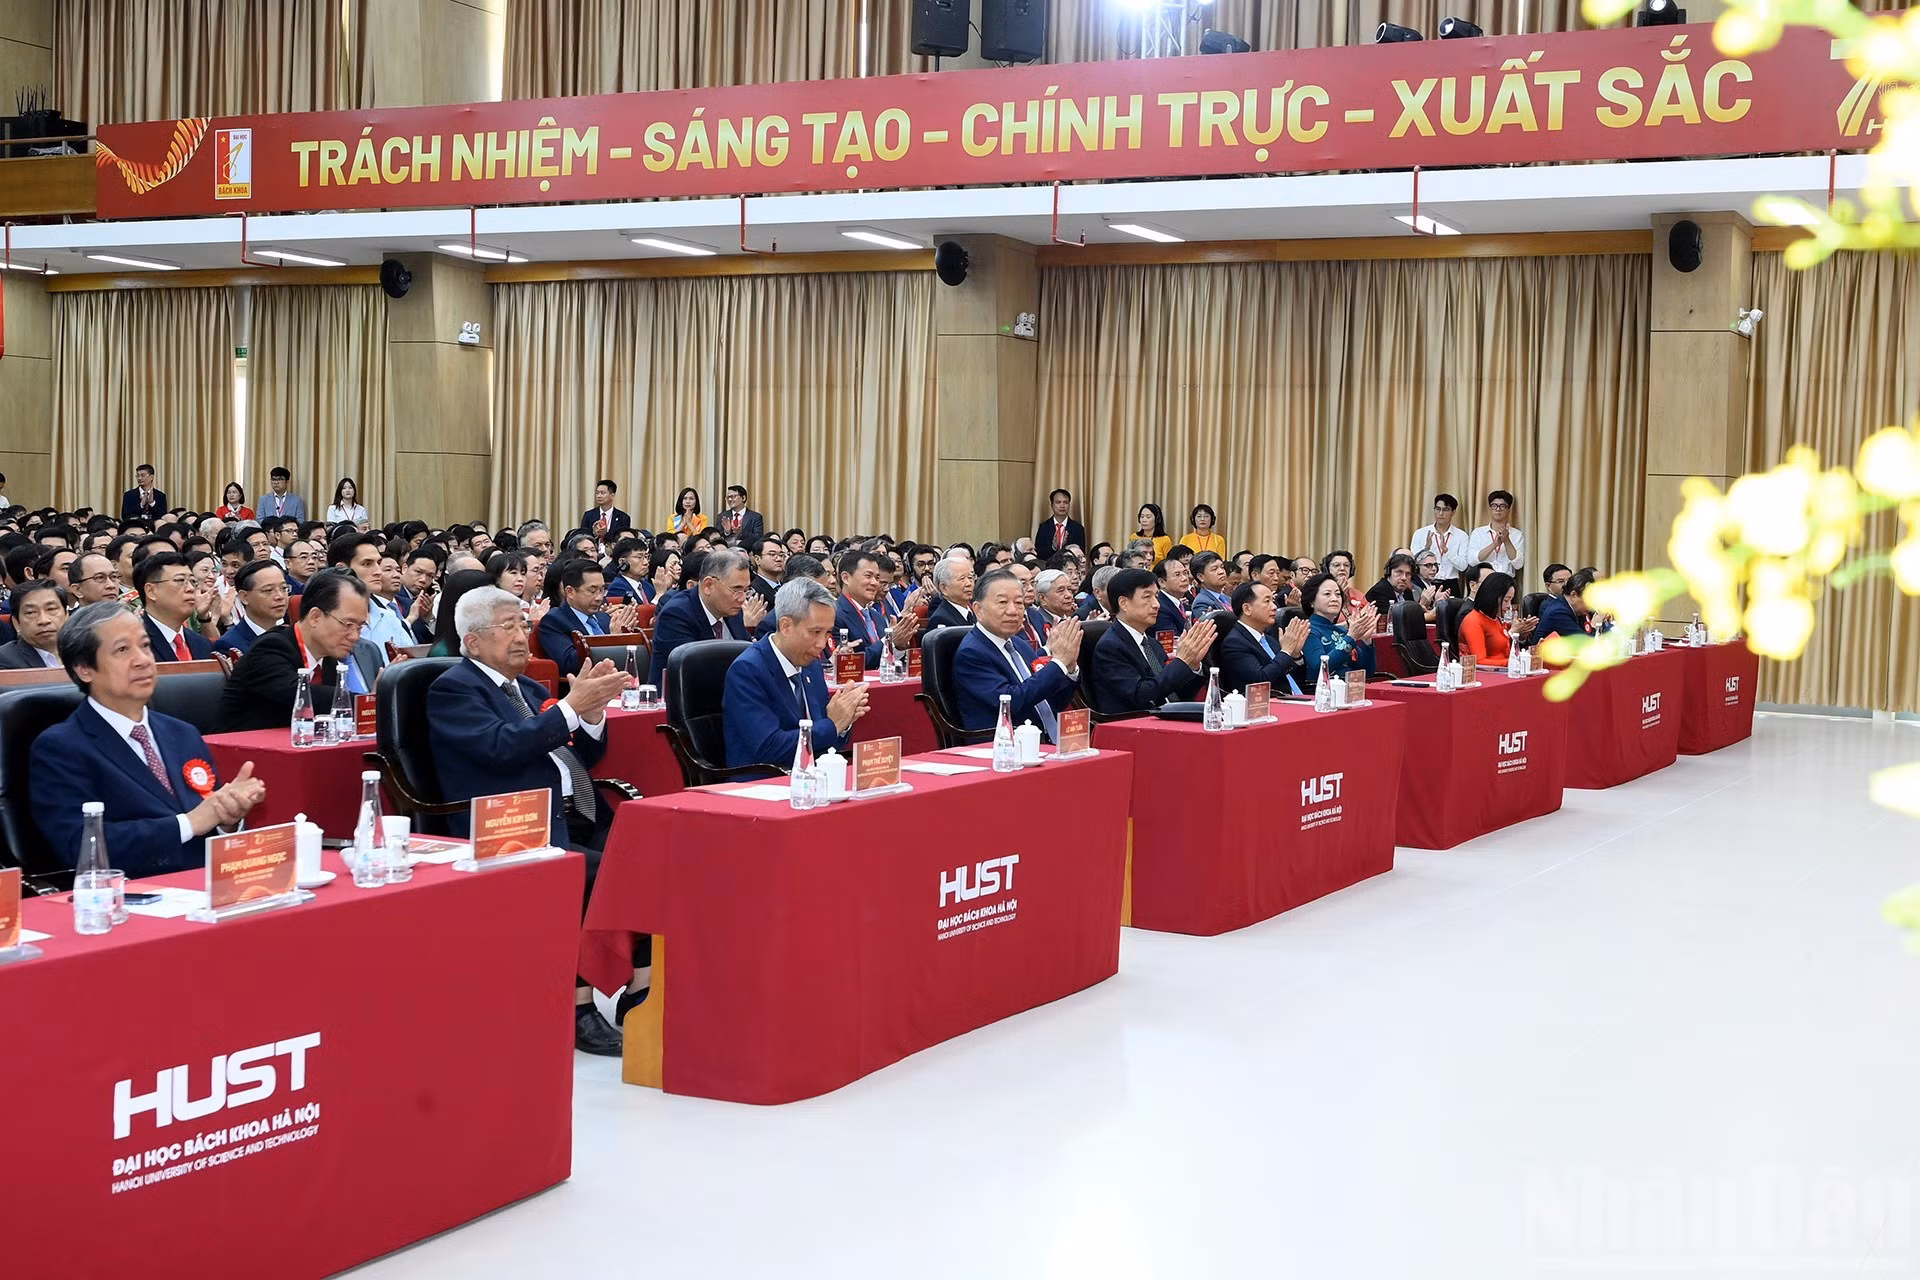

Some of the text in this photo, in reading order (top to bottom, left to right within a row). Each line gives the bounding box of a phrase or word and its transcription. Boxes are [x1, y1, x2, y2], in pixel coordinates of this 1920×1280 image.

[291, 126, 441, 188] TRÁCH
[451, 116, 599, 193] NHIỆM
[642, 107, 790, 172] SÁNG
[802, 107, 911, 179] TẠO
[962, 85, 1143, 157] CHÍNH
[1158, 79, 1330, 163] TRỰC
[1389, 50, 1582, 138] XUẤT
[1596, 34, 1752, 130] SẮC
[1498, 730, 1528, 755] HUST
[1301, 772, 1344, 807] HUST
[939, 853, 1020, 908] HUST
[950, 914, 963, 927] HỌC
[112, 1031, 321, 1140] HUST
[111, 1124, 320, 1195] HANOI UNIVERSITY OF SCIENCE AND TECHNOLOGY
[112, 1102, 320, 1177] ĐẠI HỌC BÁCH KHOA HÀ NỘI
